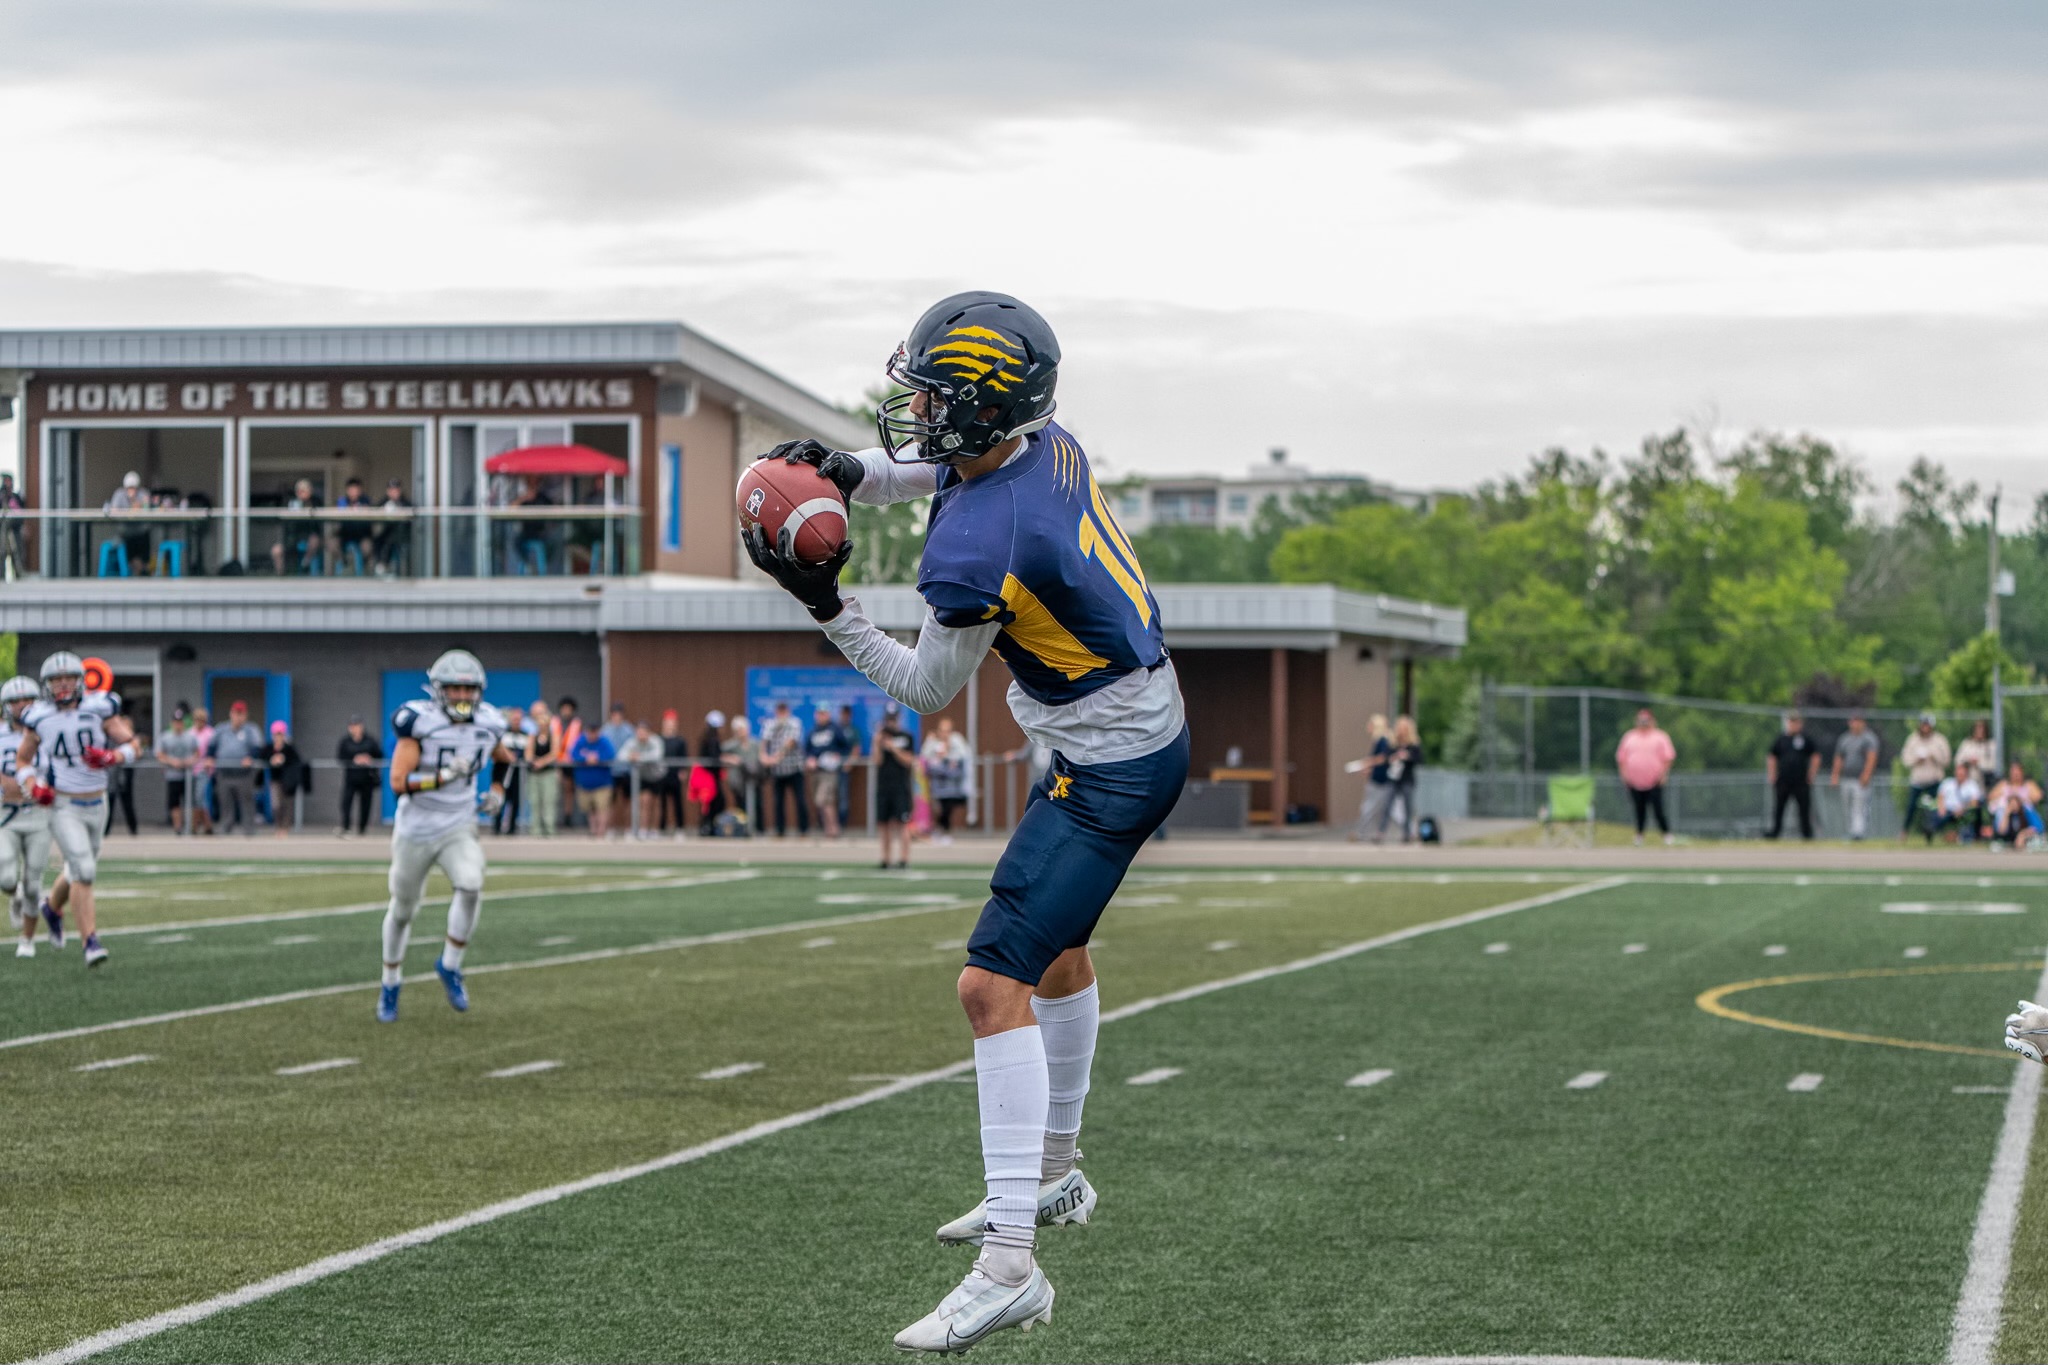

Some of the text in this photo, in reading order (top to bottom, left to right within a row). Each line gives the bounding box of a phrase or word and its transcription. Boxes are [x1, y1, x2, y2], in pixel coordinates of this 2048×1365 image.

[47, 379, 634, 411] HOME OF THE STEELHAWKS
